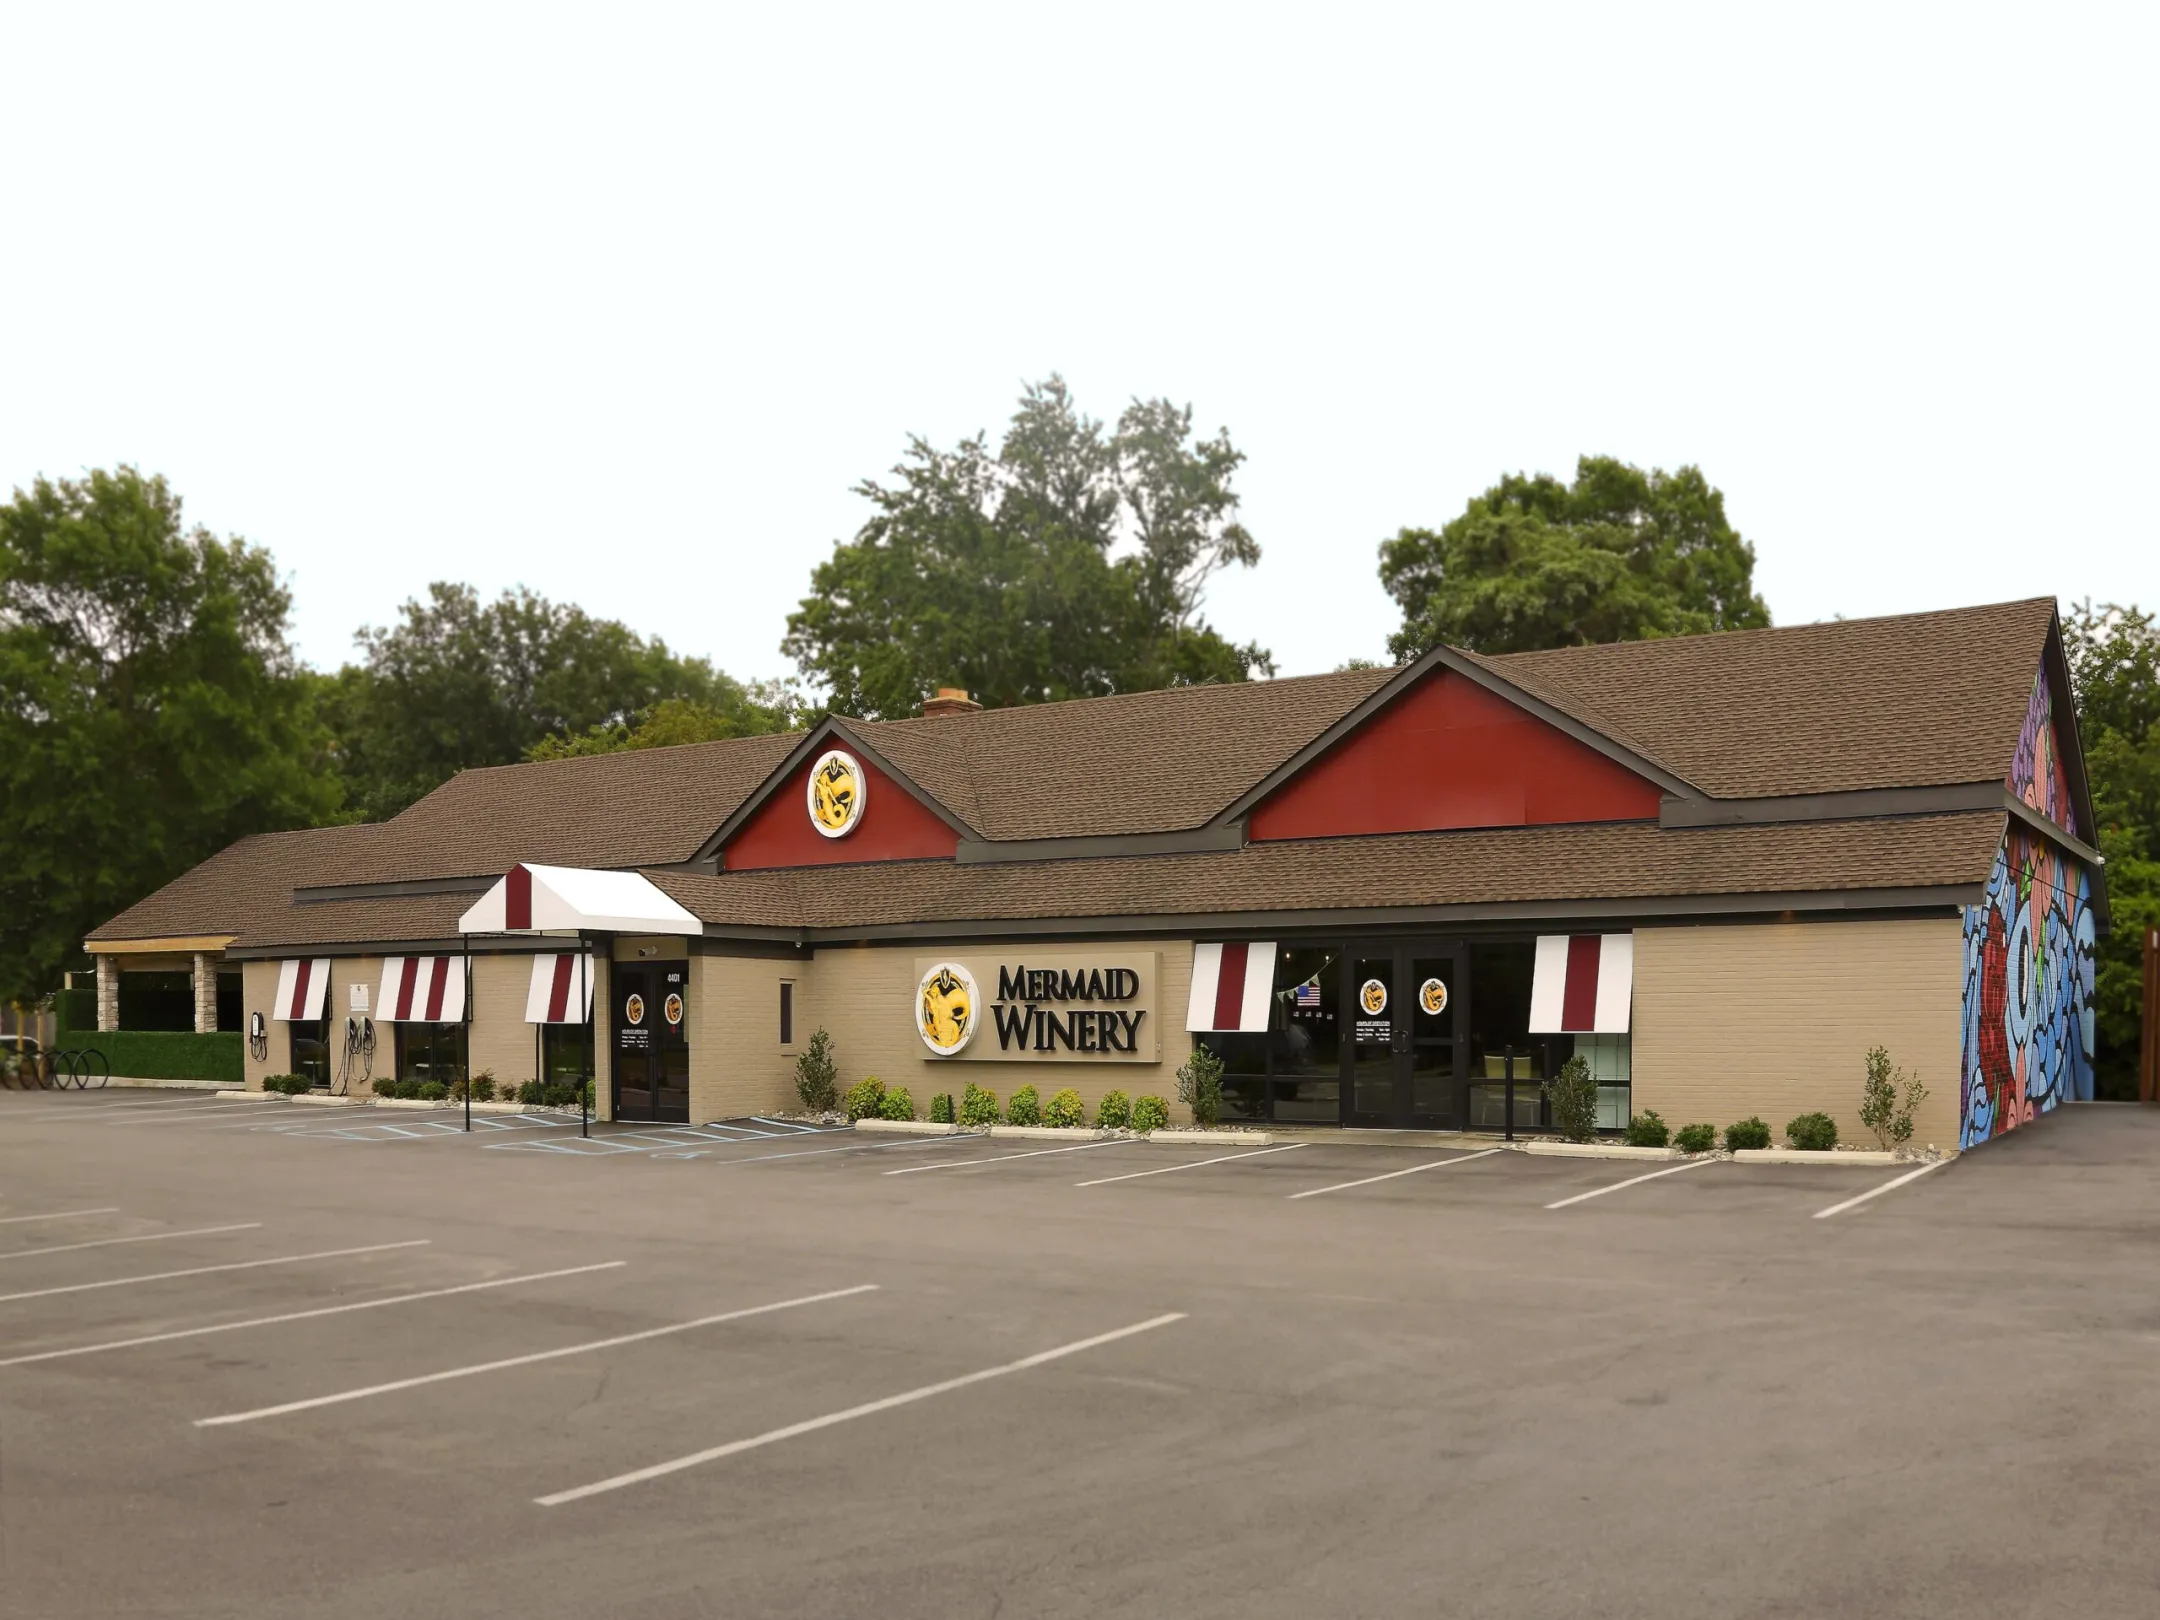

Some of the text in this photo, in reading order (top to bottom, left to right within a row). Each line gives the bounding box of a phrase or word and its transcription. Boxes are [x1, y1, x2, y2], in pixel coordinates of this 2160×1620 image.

[667, 973, 680, 982] 4401
[996, 964, 1140, 1001] MERMAID
[990, 1004, 1147, 1052] WINERY
